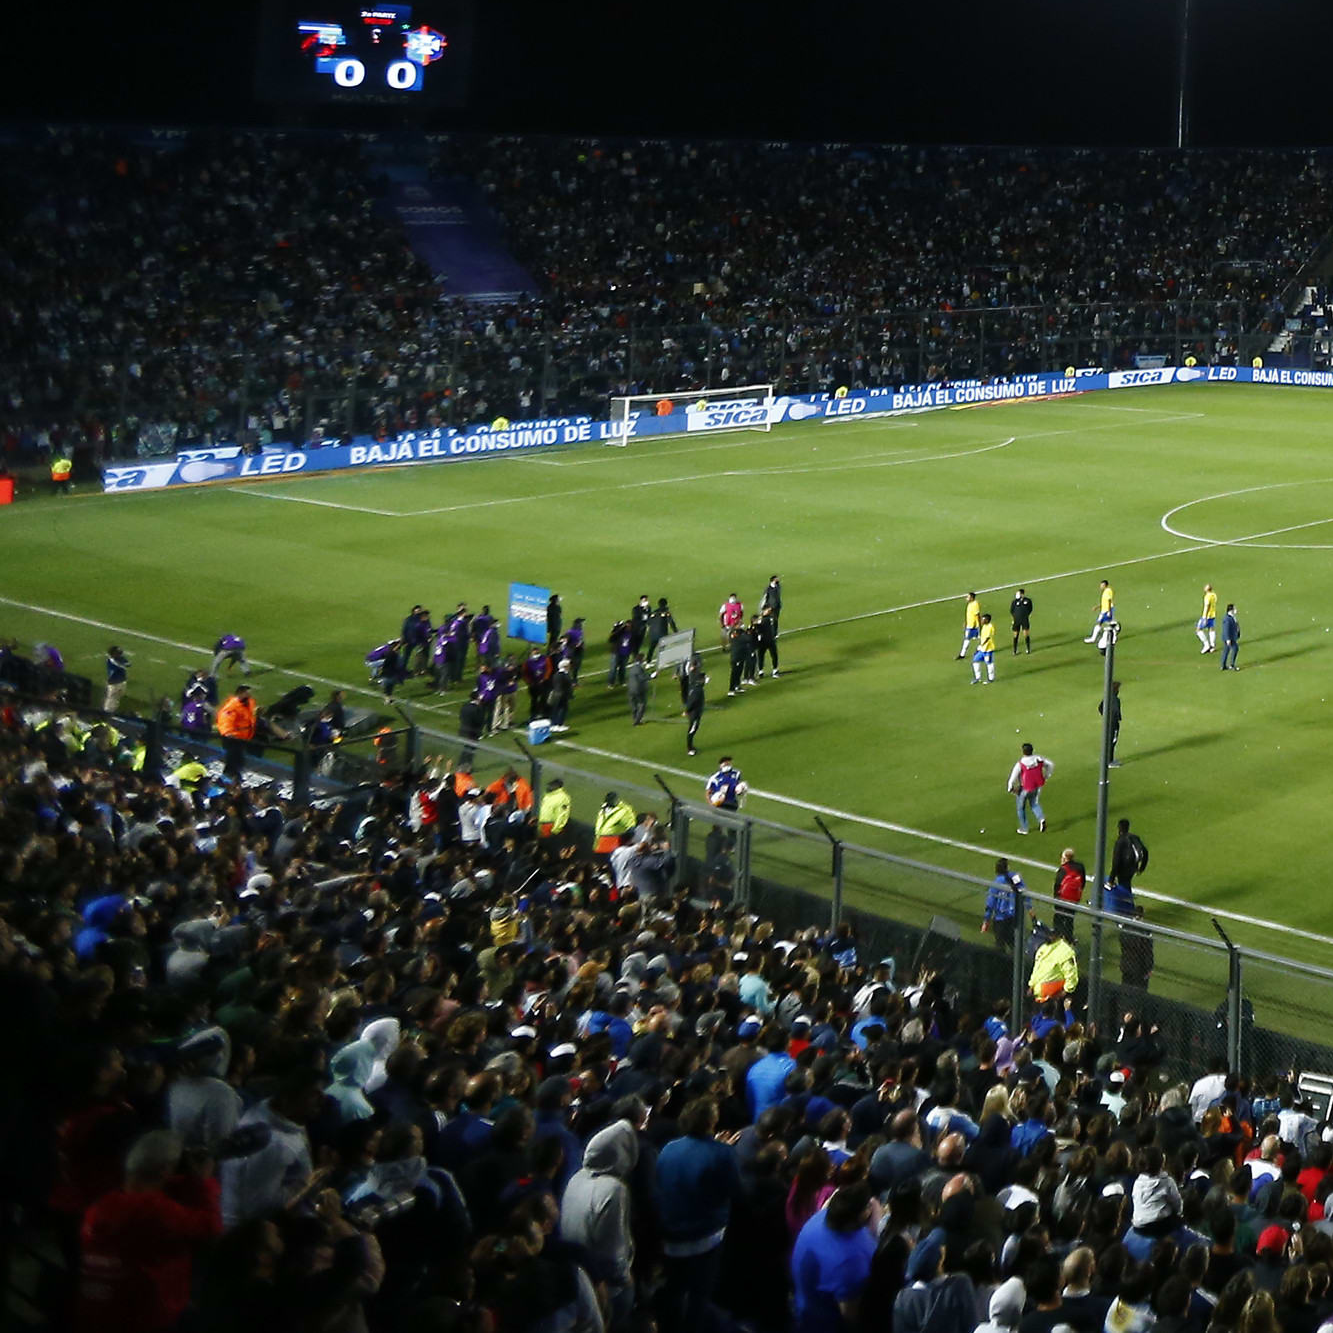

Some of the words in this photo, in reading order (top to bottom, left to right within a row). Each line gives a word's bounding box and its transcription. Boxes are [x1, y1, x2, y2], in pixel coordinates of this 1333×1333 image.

[334, 59, 365, 87] 0
[387, 61, 417, 89] 0
[1208, 367, 1237, 381] LED
[1252, 367, 1279, 383] BAJÁ
[1280, 370, 1293, 384] EL
[893, 387, 932, 409] BAJÁ
[935, 387, 954, 405] EL
[955, 383, 1025, 403] CONSUMO
[1028, 381, 1046, 395] DE
[1051, 378, 1076, 393] LUZ
[825, 398, 866, 416] LED
[350, 437, 413, 464] BAJÁ
[418, 436, 446, 457] EL
[450, 428, 553, 455] CONSUMO
[564, 424, 591, 442] DE
[600, 419, 640, 439] LUZ
[240, 453, 306, 477] LED
